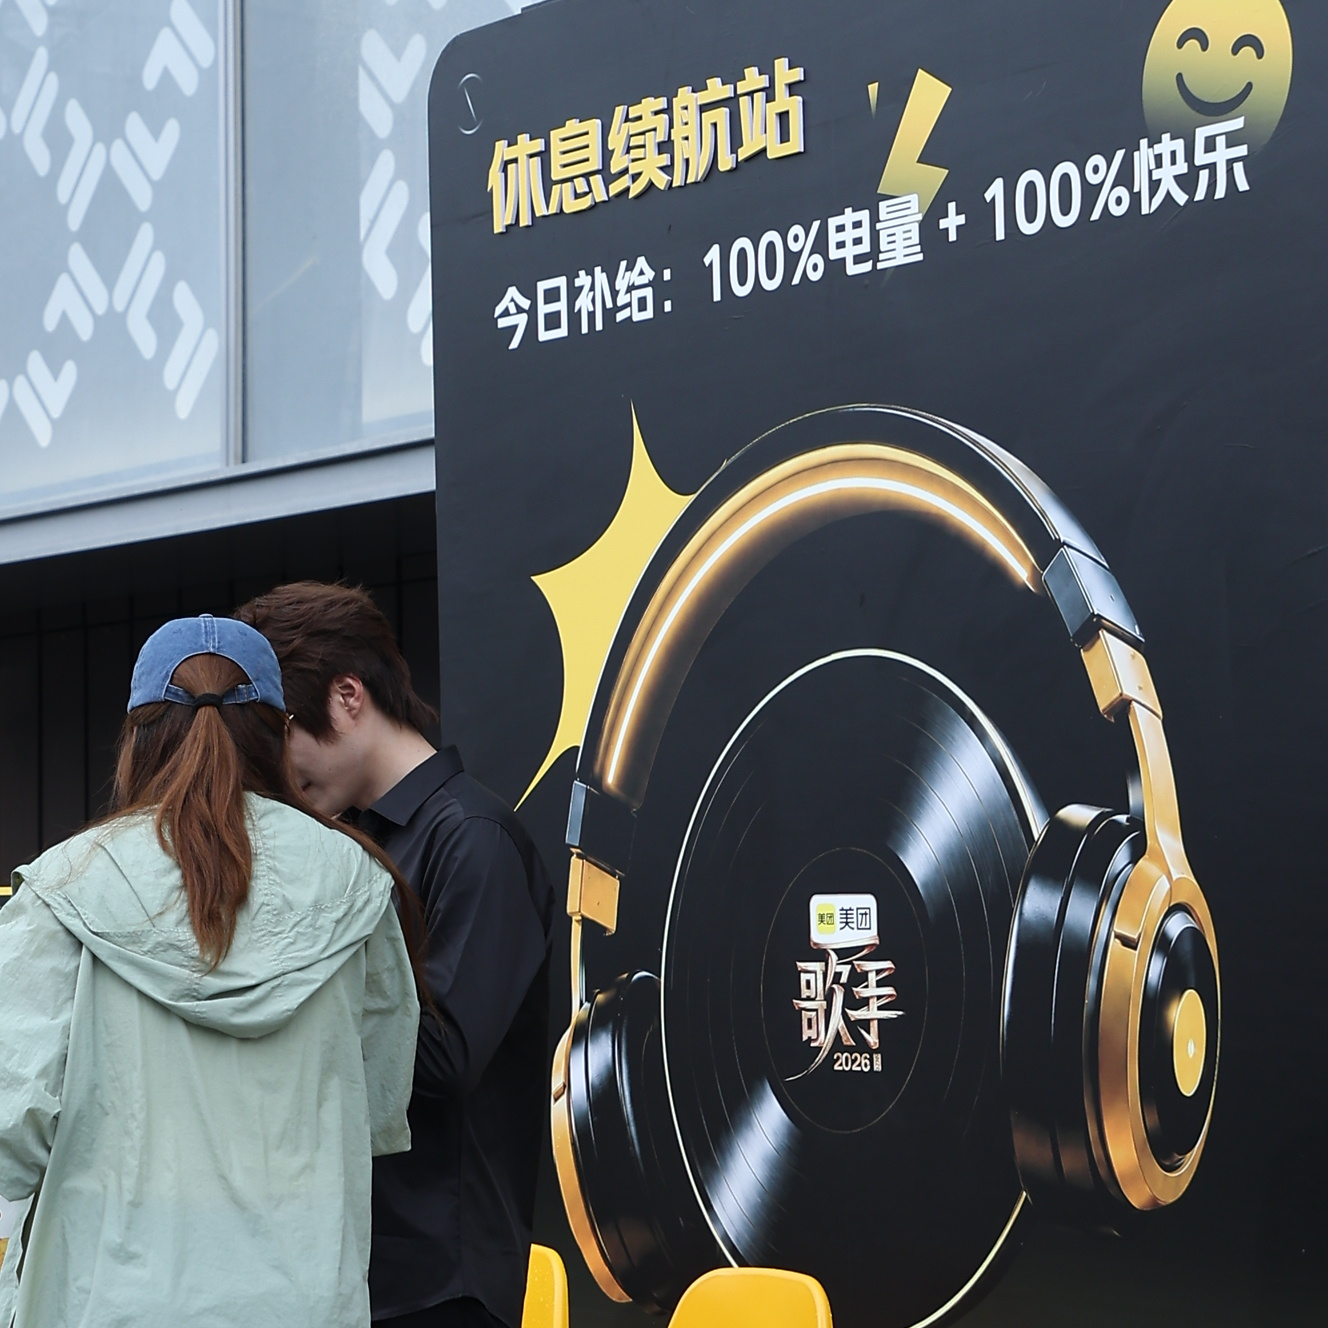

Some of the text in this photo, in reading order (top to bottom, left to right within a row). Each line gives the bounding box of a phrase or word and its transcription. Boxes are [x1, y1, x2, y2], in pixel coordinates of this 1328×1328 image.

[487, 56, 806, 235] 休息续航站
[983, 115, 1250, 243] 100%快乐
[817, 912, 834, 926] 美团
[838, 906, 872, 931] 美团
[783, 949, 905, 1082] 歌手
[833, 1052, 871, 1072] 2026
